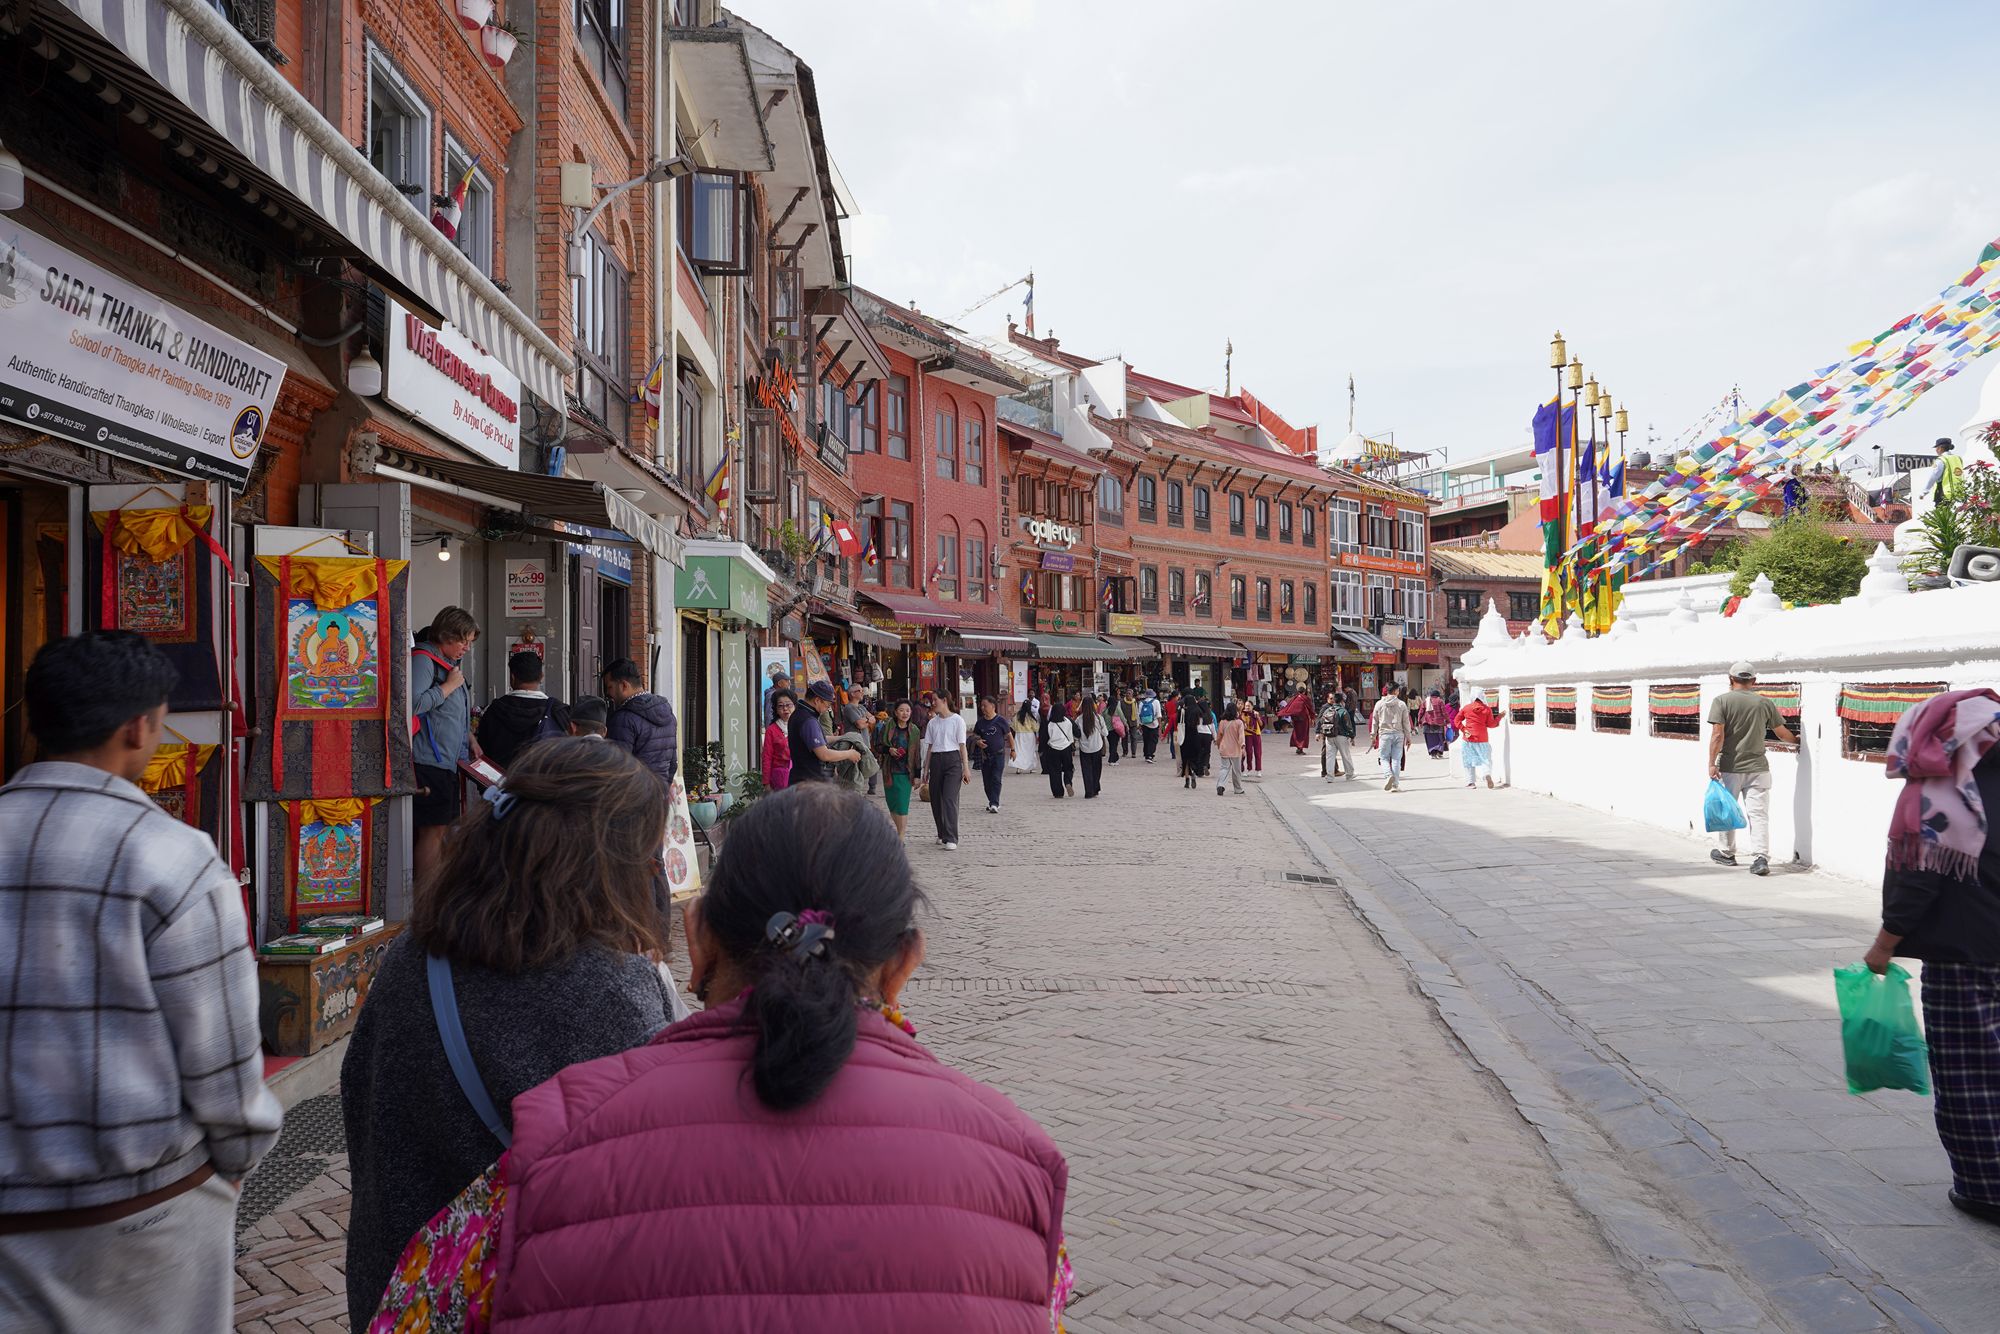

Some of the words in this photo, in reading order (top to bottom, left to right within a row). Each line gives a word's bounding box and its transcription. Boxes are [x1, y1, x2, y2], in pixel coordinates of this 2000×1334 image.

[40, 267, 95, 320] SARA
[98, 293, 168, 354] THANKA
[168, 331, 183, 361] &
[184, 336, 273, 400] HANDICRAFT
[8, 355, 57, 384] Authentic
[58, 372, 116, 405] Handicrafted
[116, 394, 155, 420] Thangkas
[161, 411, 199, 437] Wholesale
[203, 428, 226, 446] Export
[69, 329, 102, 354] School
[101, 345, 112, 359] of
[113, 347, 147, 373] Thangka
[146, 363, 162, 380] Art
[161, 368, 193, 396] Painting
[193, 383, 213, 401] Since
[215, 391, 232, 410] 1976
[405, 313, 482, 397] Vietnamese
[481, 373, 518, 424] Cuisine
[40, 411, 52, 421] +977
[63, 419, 73, 428] 312
[73, 421, 87, 431] 3212
[453, 400, 463, 421] By
[463, 409, 480, 431] Ariya
[480, 418, 494, 440] Café
[493, 427, 504, 446] Pvt.
[1001, 474, 1010, 537] COFFEE
[530, 572, 545, 584] 99
[603, 545, 613, 563] Arts
[618, 550, 631, 571] Crafts
[727, 642, 742, 707] TAWA
